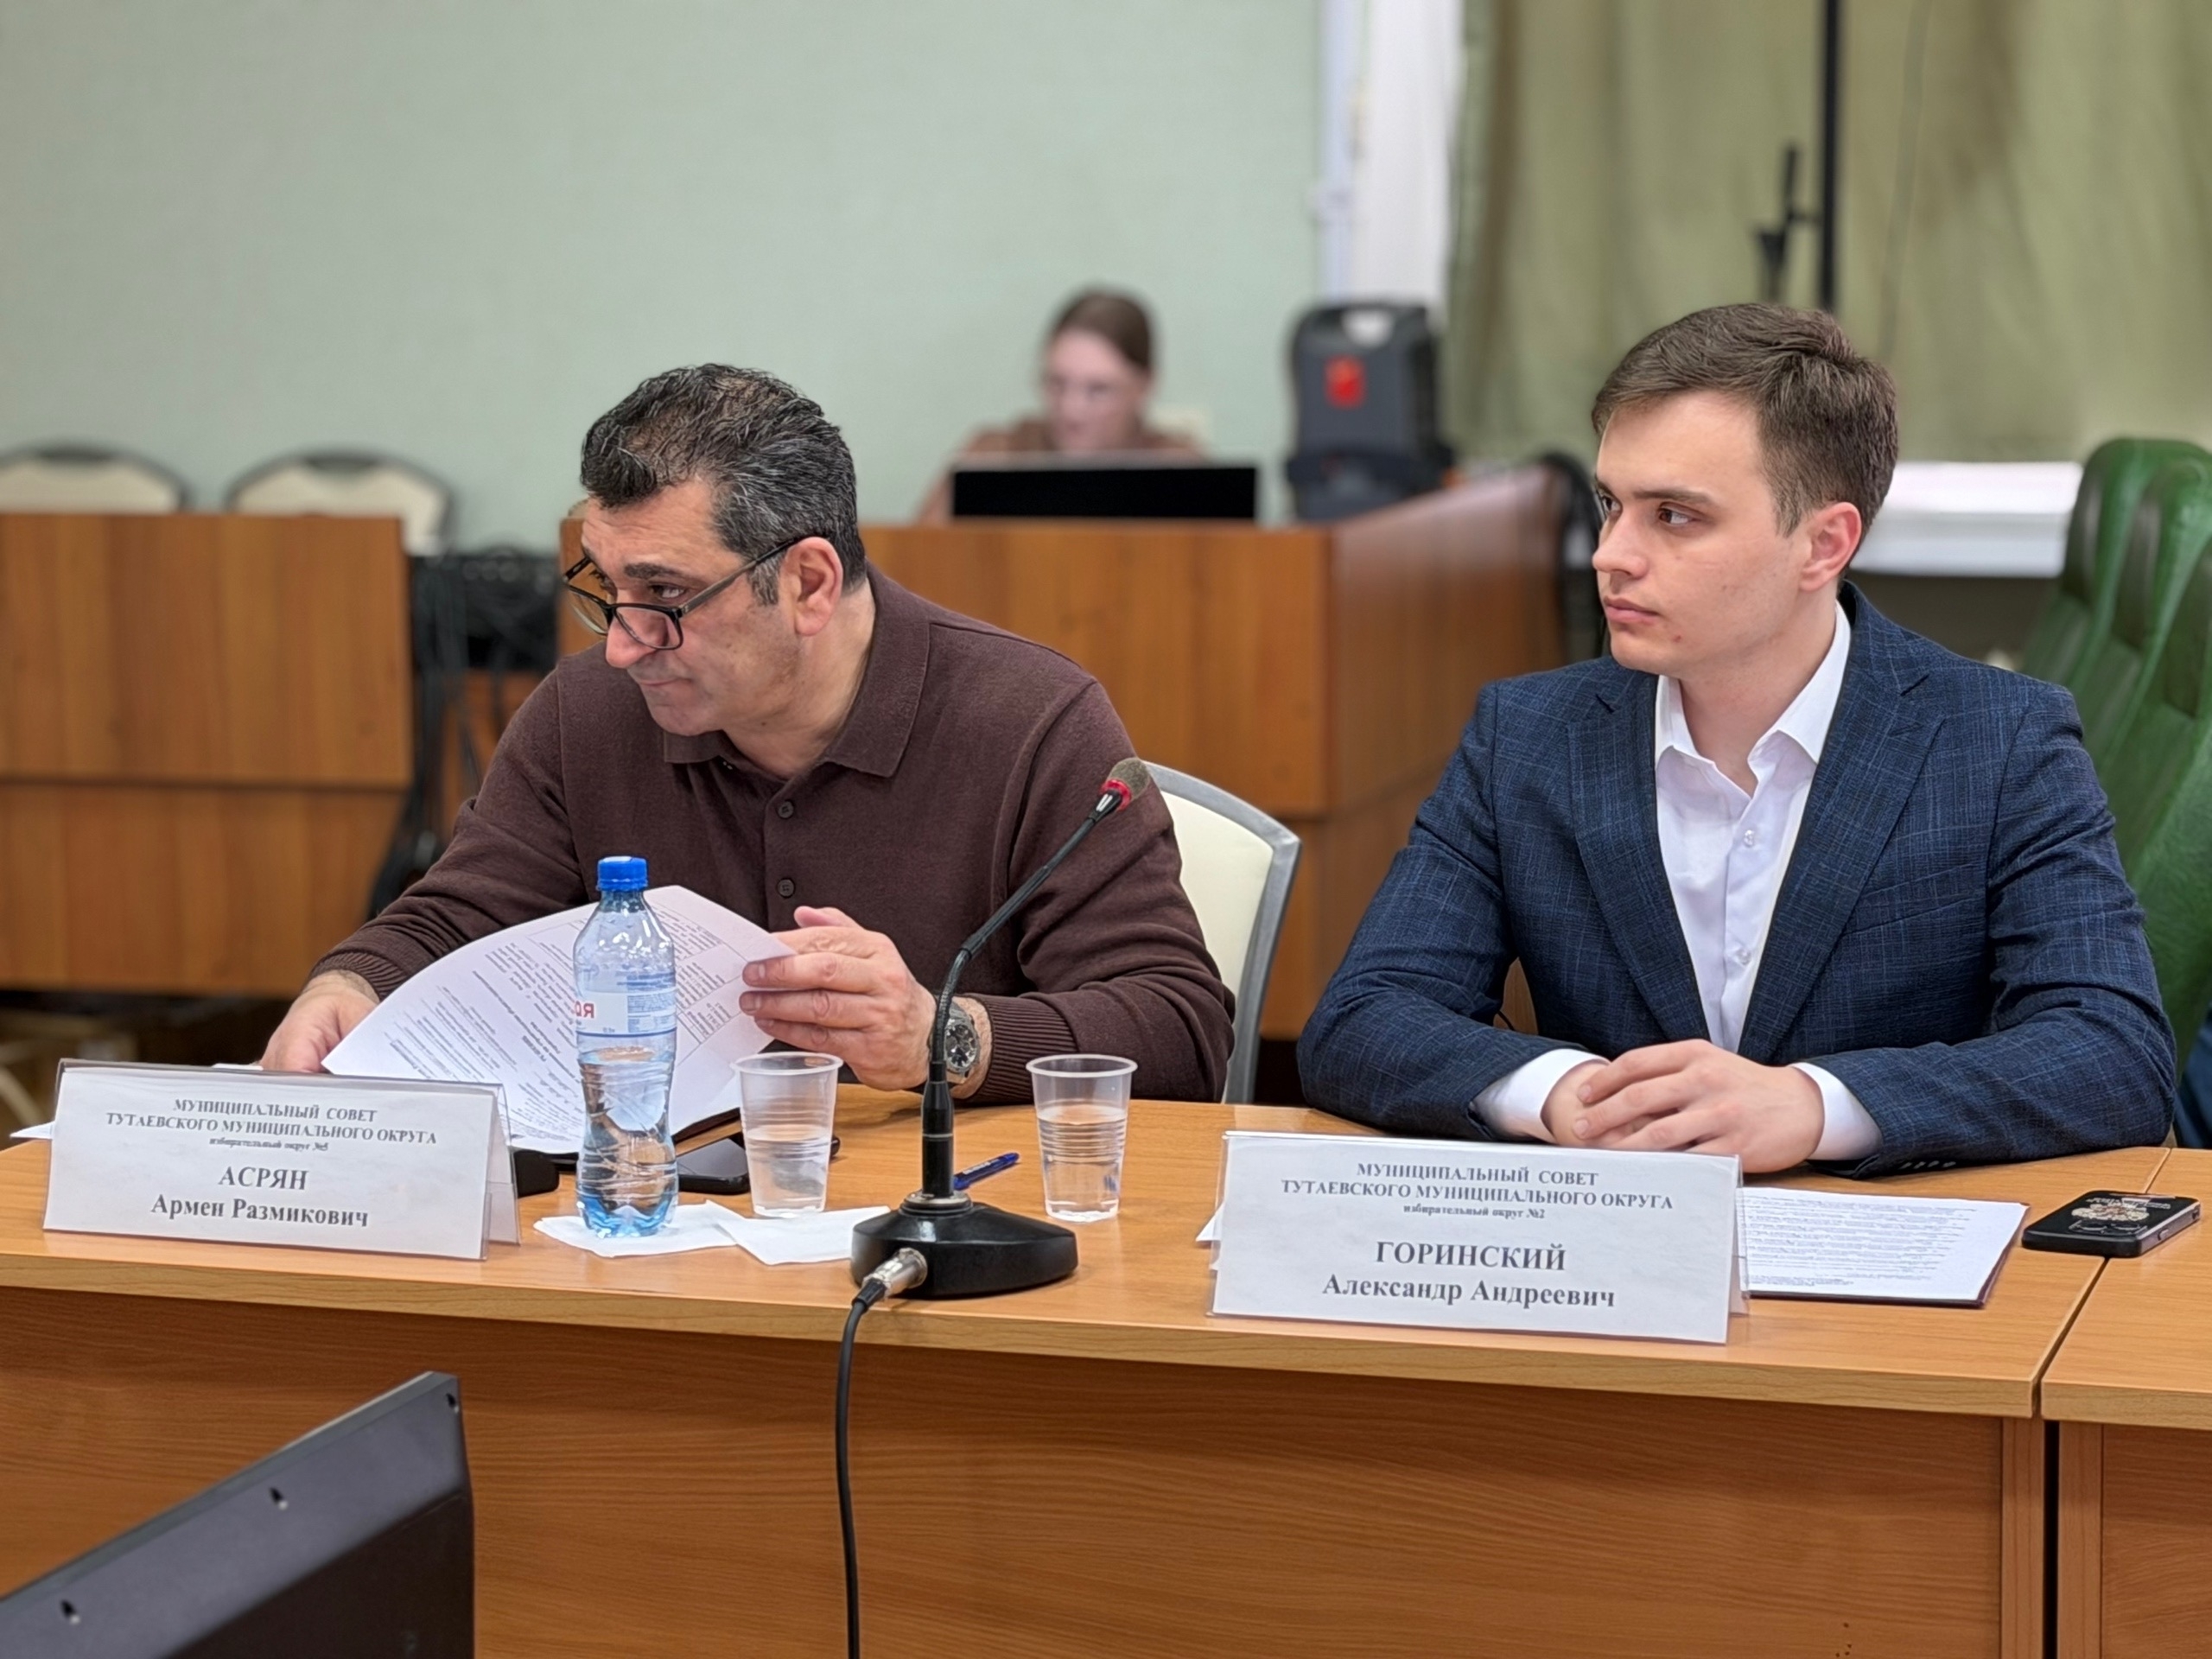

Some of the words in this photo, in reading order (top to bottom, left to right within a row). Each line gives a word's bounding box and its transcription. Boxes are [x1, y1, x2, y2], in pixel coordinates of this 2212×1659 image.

[174, 1099, 320, 1120] МУНИЦИПАЛЬНЫЙ
[326, 1107, 378, 1122] СОВЕТ
[106, 1112, 219, 1132] ТУТАЕВСКОГО
[222, 1120, 374, 1141] МУНИЦИПАЛЬНОГО
[377, 1128, 437, 1145] ОКРУГА
[218, 1166, 308, 1191] АСРЯН
[1357, 1163, 1529, 1184] МУНИЦИПАЛЬНЫЙ
[1538, 1170, 1599, 1186] СОВЕТ
[1281, 1179, 1412, 1199] ТУТАЕВСКОГО
[1414, 1185, 1597, 1206] МУНИЦИПАЛЬНОГО
[1600, 1192, 1674, 1210] ОКРУГА
[150, 1194, 226, 1220] Армен
[230, 1198, 369, 1227] Размикович
[1376, 1242, 1567, 1271] ГОРИНСКИЙ
[1322, 1274, 1463, 1306] Александр
[1469, 1280, 1616, 1310] Андреевич
